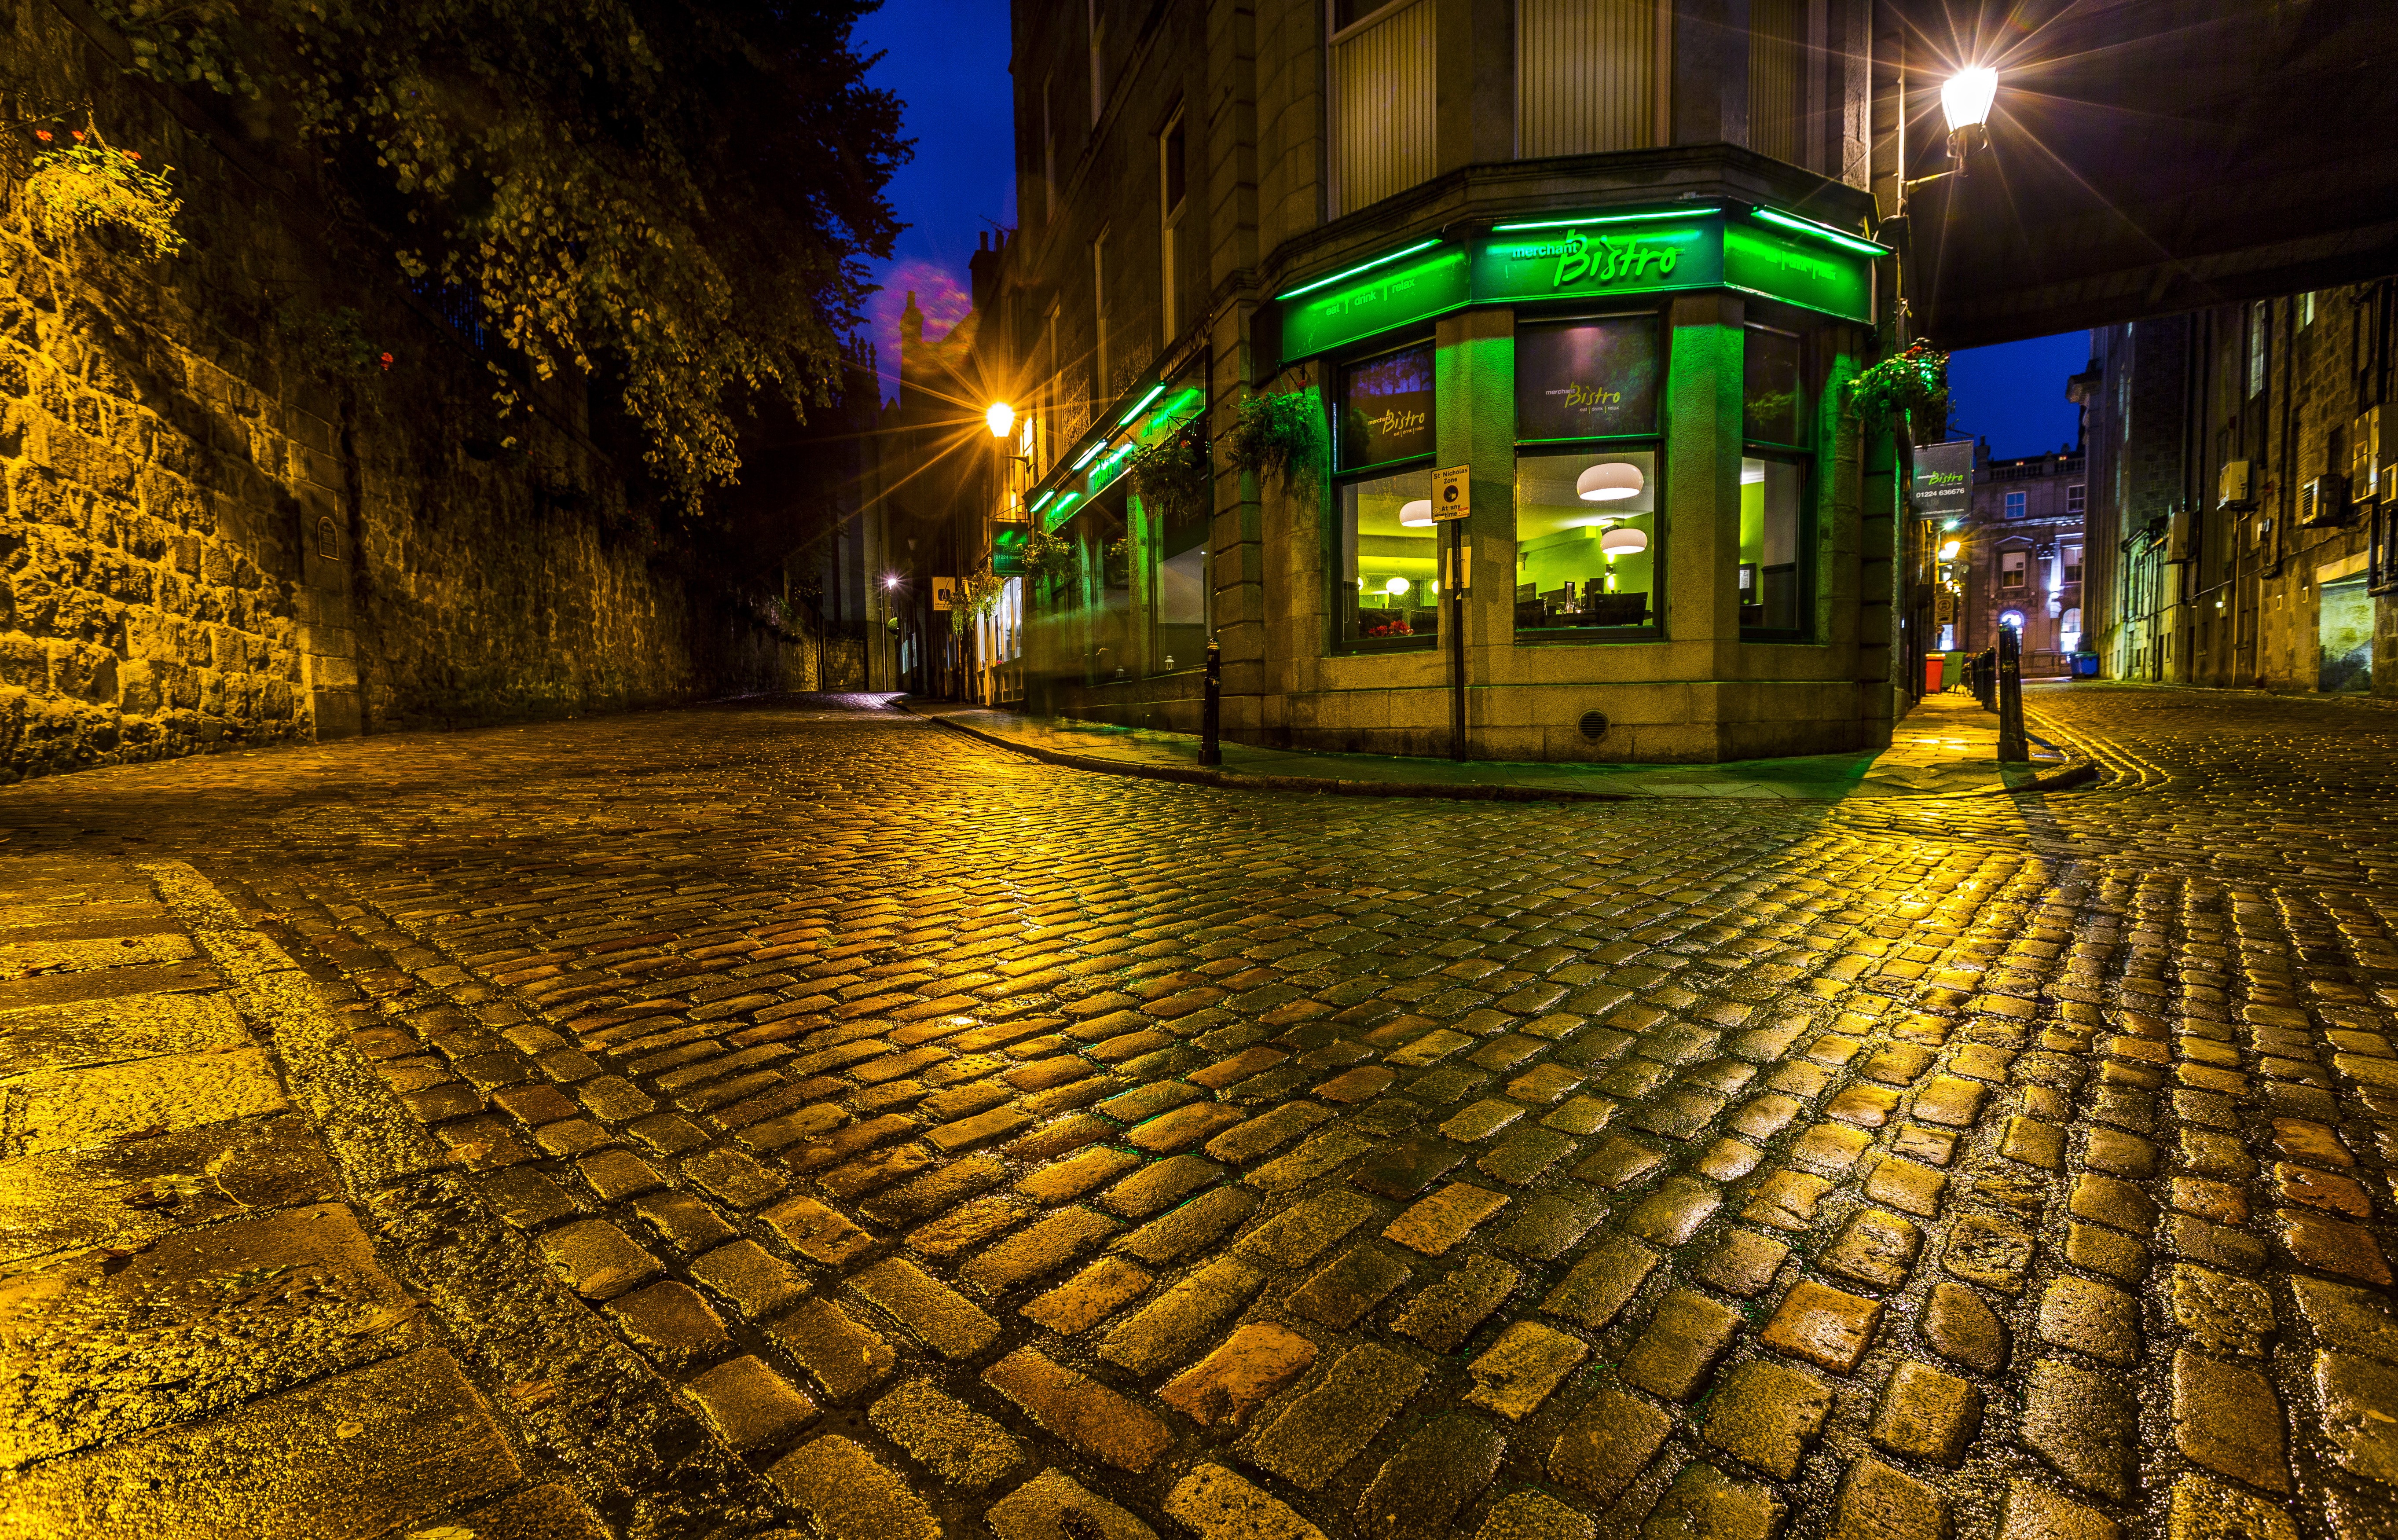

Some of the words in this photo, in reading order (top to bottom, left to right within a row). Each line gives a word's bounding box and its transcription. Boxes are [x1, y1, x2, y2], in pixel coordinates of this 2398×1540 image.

[1512, 241, 1578, 258] merchant
[1554, 228, 1685, 287] Bistro
[1326, 303, 1340, 316] eat
[1354, 290, 1376, 306] drink
[1391, 278, 1415, 293] relax
[1564, 381, 1621, 408] Bistro
[1368, 415, 1390, 425] merchant
[1382, 409, 1425, 435] Bistro
[1443, 468, 1468, 477] Nicholas
[1928, 470, 1963, 485] Bistro
